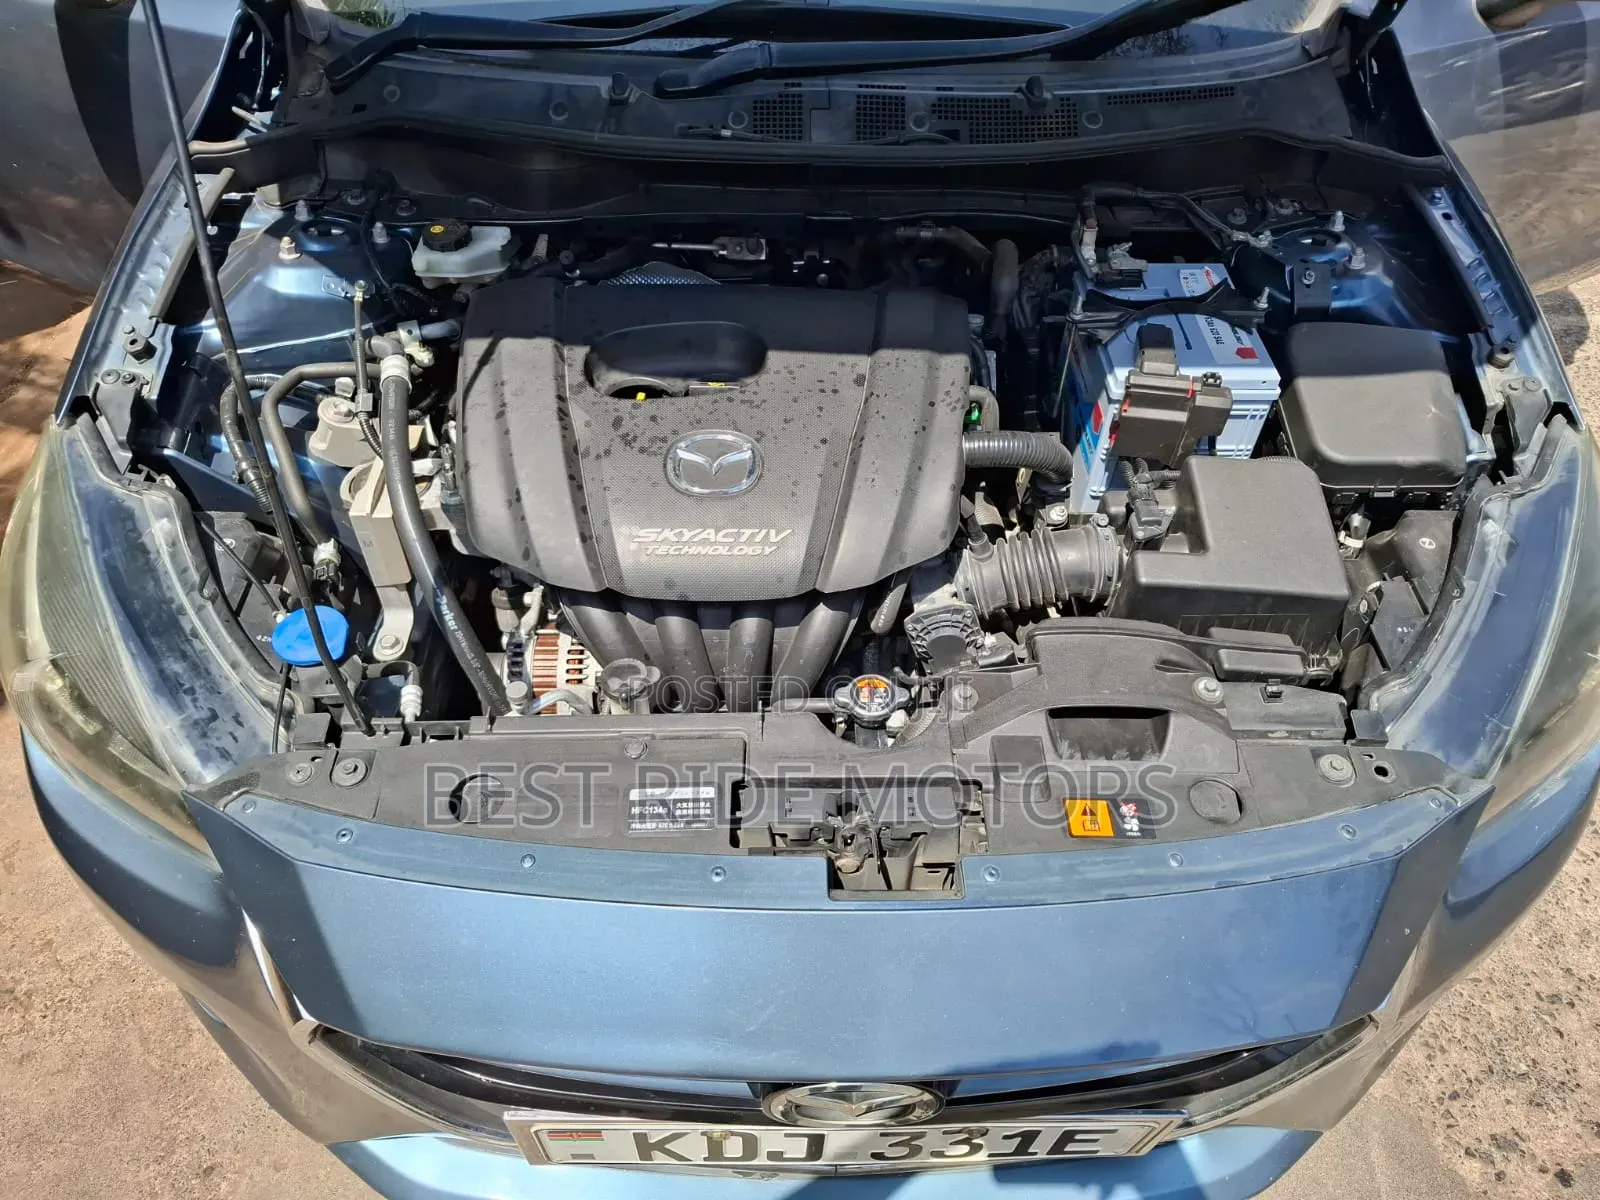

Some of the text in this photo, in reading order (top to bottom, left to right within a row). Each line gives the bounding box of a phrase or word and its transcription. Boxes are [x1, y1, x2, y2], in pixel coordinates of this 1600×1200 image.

[632, 528, 793, 543] SKYACTIV
[646, 545, 778, 556] TECHNOLOGY
[437, 595, 458, 630] Parker
[633, 1128, 1119, 1162] KDJ 331E
